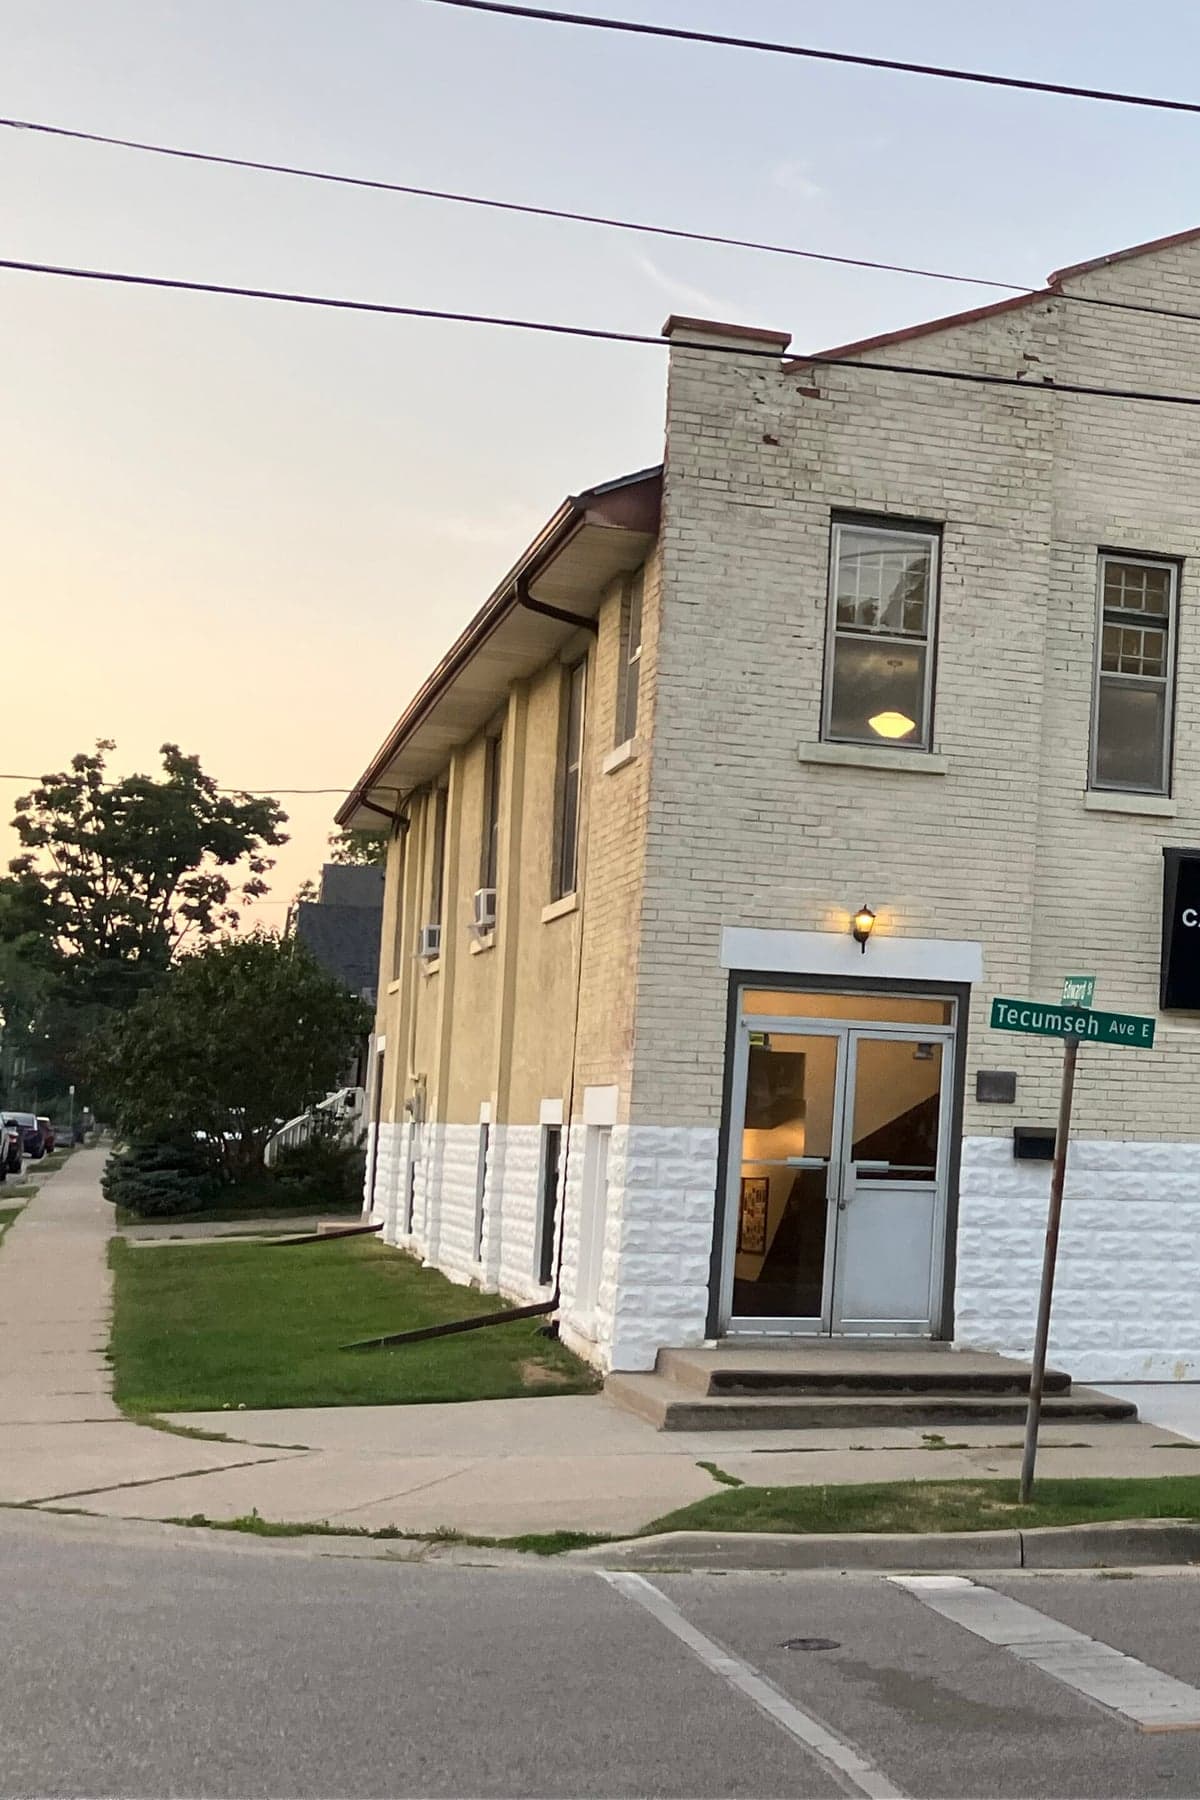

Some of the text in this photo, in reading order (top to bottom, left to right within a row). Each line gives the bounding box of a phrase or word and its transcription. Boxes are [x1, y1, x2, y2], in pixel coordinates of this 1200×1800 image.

[997, 1003, 1150, 1038] Tecumseh Ave E
